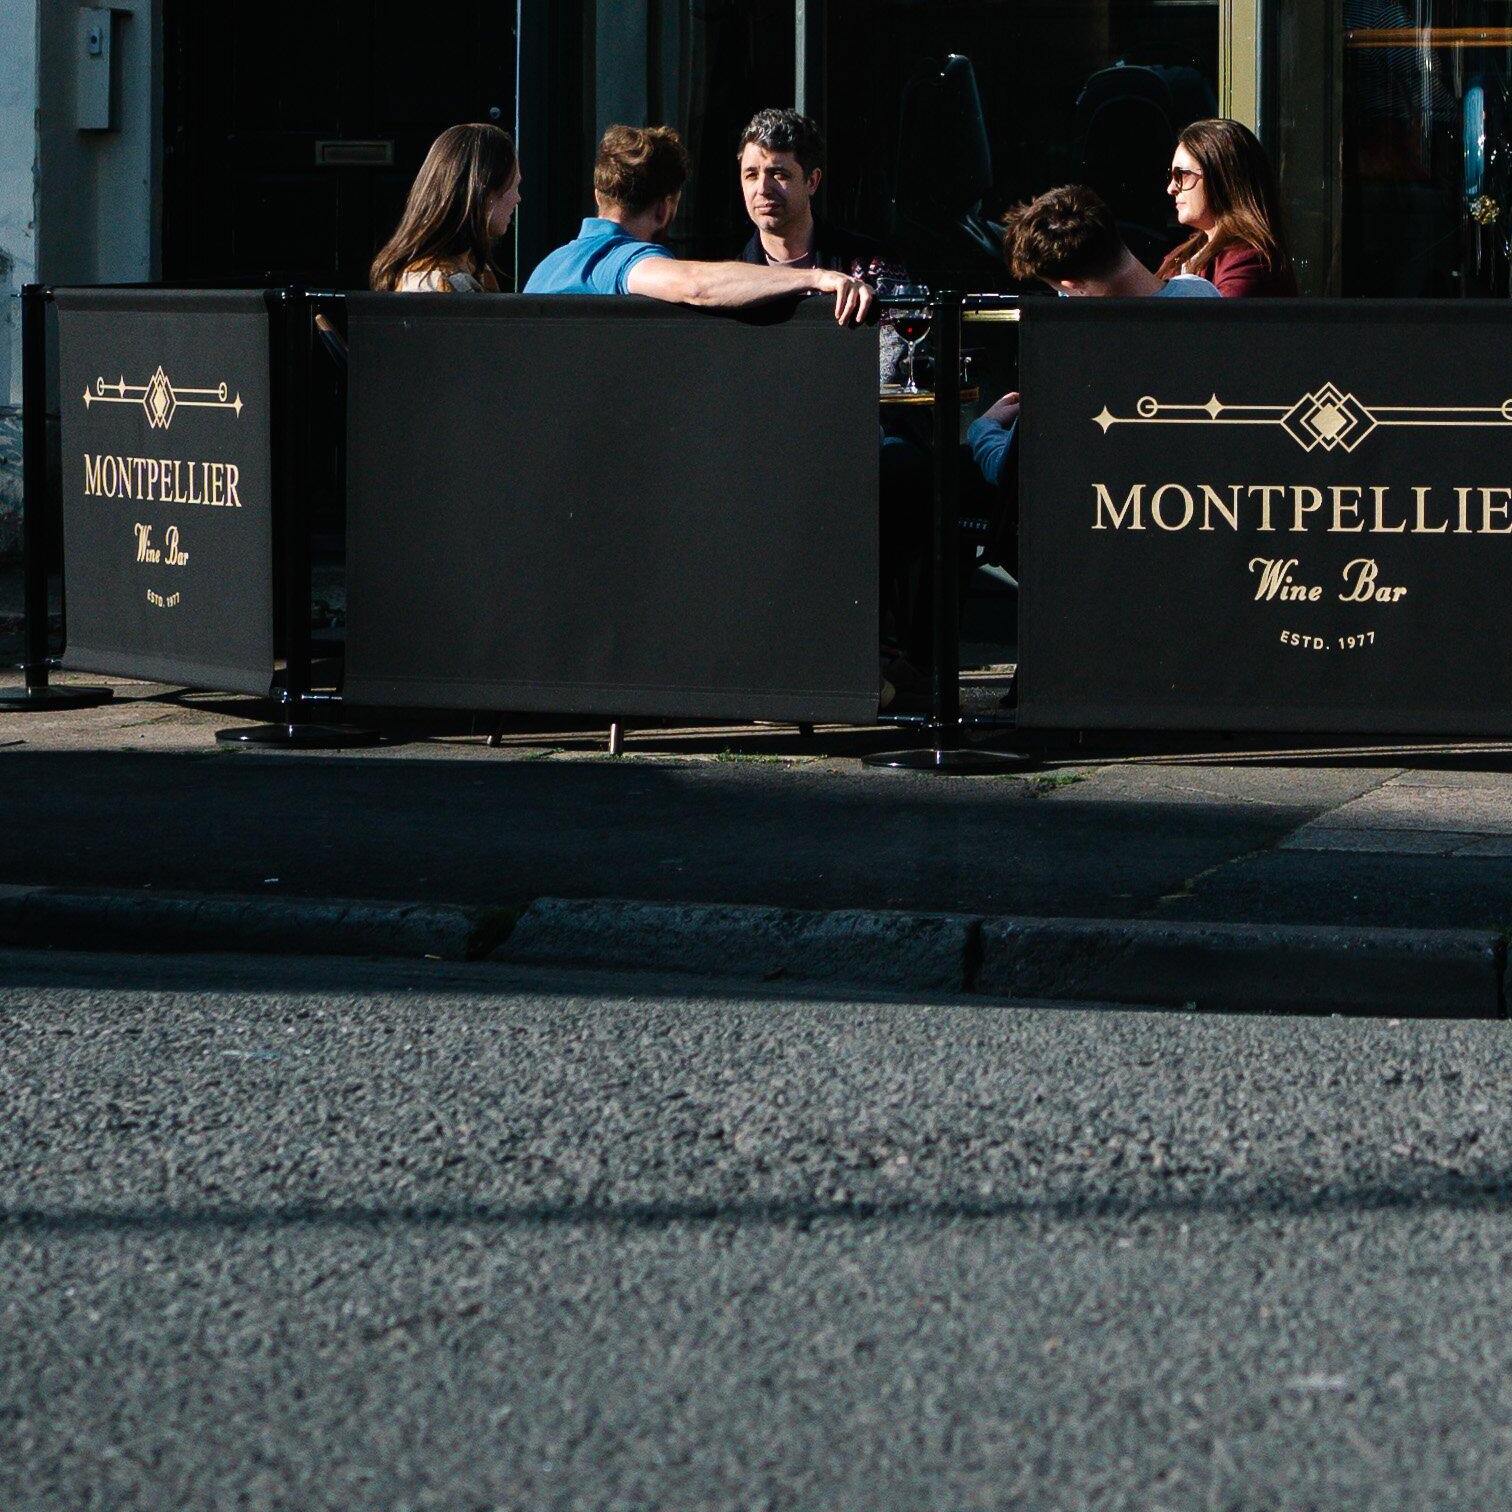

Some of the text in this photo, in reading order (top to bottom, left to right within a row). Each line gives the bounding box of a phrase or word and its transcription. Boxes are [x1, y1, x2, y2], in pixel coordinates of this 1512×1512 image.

[84, 453, 242, 507] MONTPELLIER
[134, 522, 189, 566] Wine Bar
[1248, 557, 1407, 603] Wine Bar
[1280, 630, 1377, 650] ESTD. 1977
